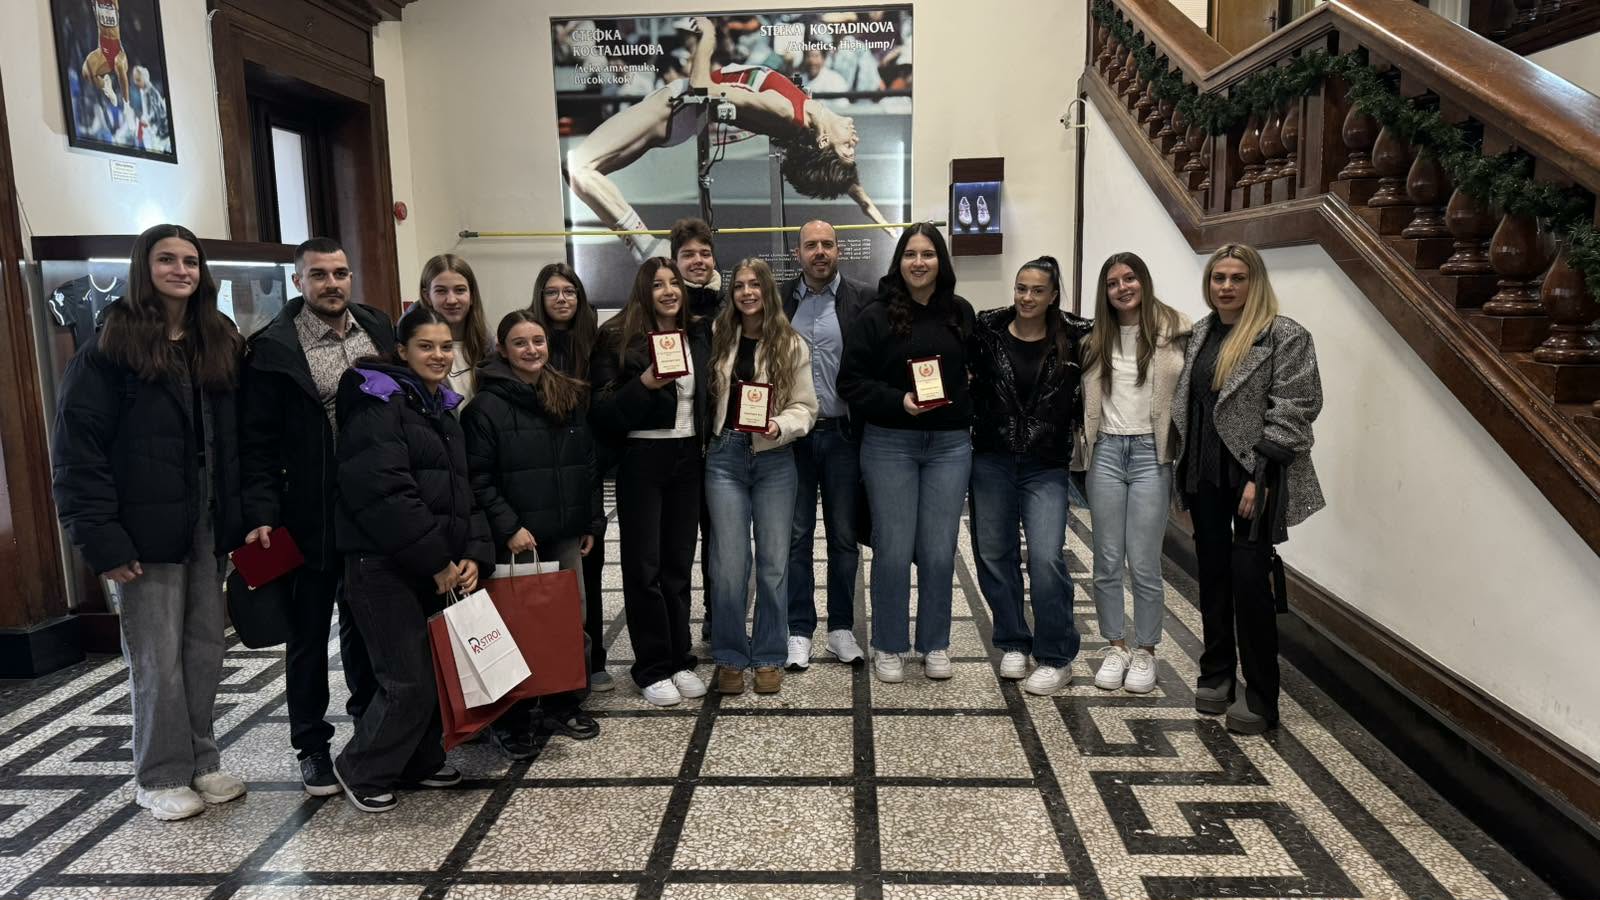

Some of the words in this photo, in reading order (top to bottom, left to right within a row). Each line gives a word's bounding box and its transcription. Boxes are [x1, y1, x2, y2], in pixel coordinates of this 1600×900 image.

[760, 23, 802, 36] STEFKA
[810, 21, 895, 35] KOSTADINOVA
[572, 29, 622, 42] СТЕФКА
[573, 44, 664, 56] КОСТАДИНОВА
